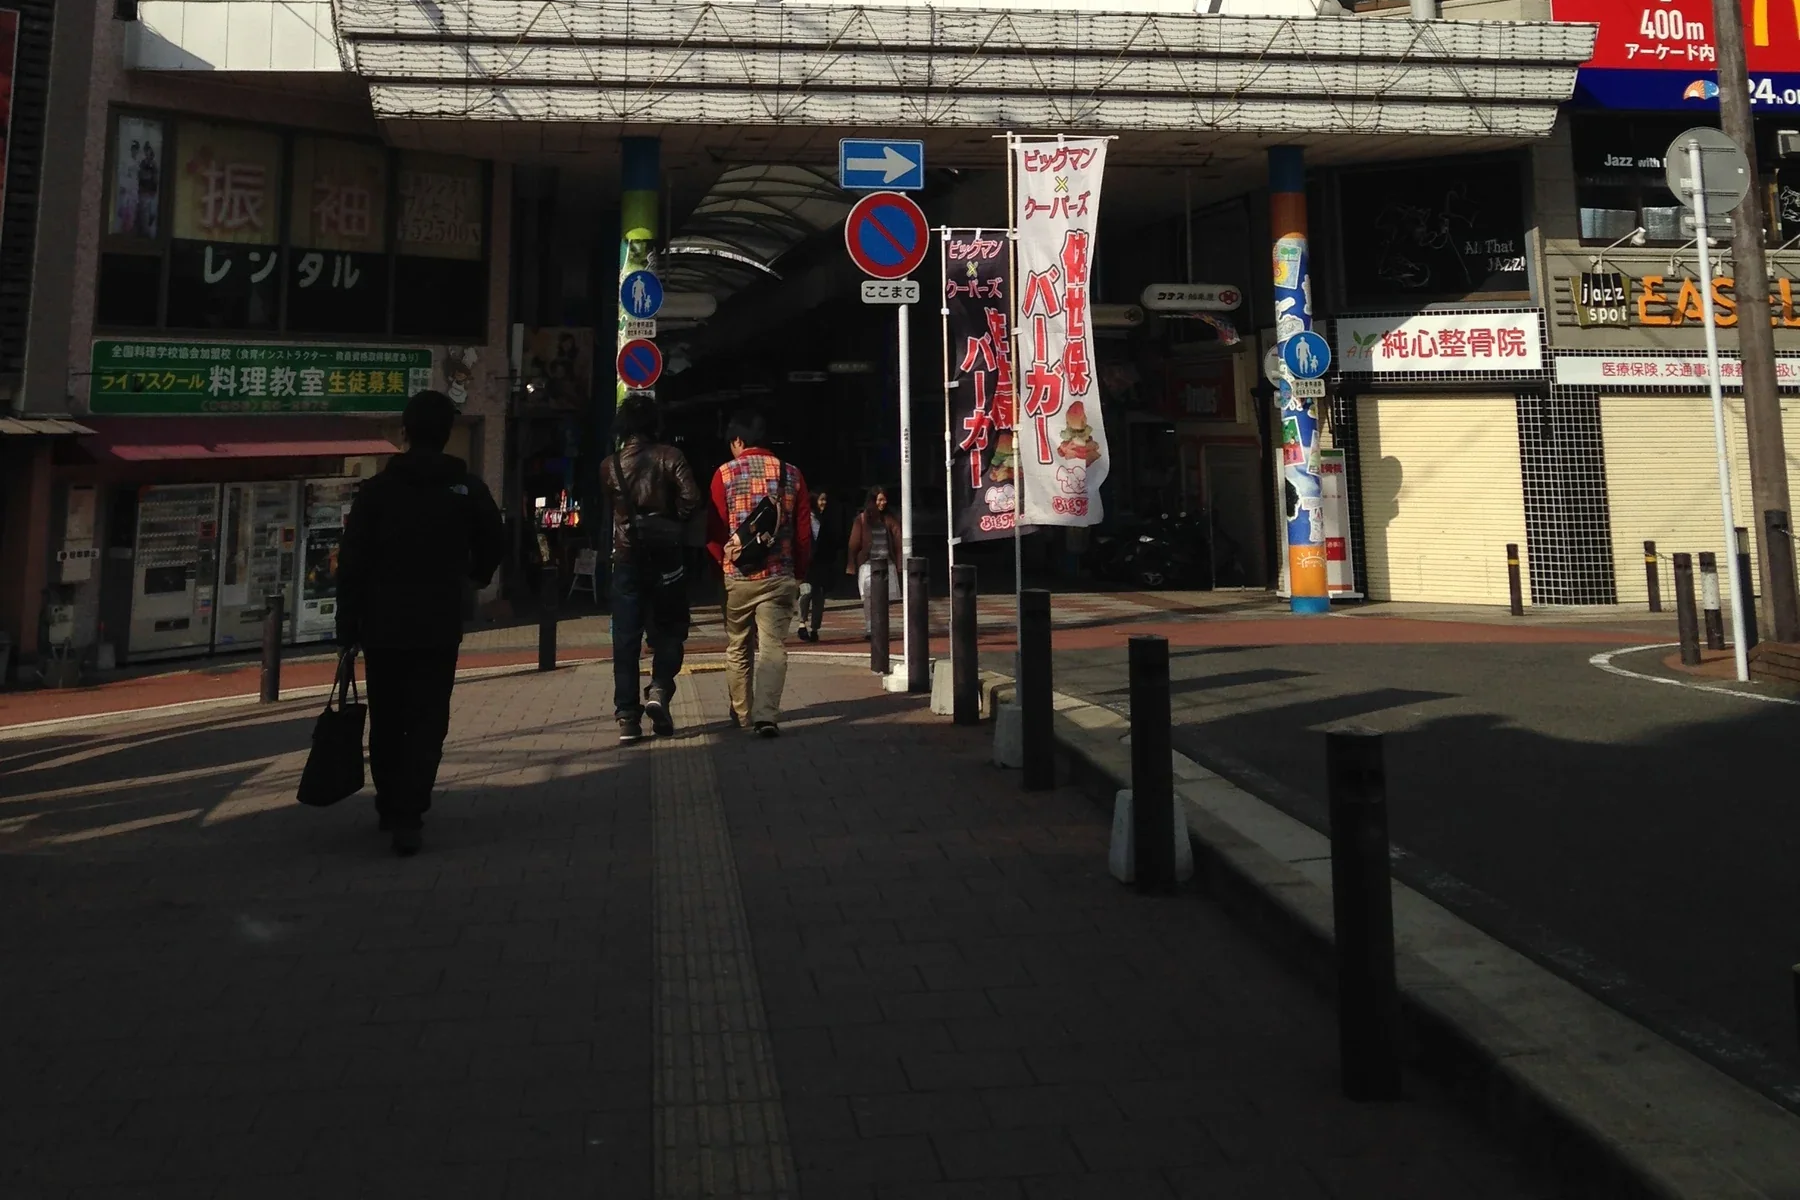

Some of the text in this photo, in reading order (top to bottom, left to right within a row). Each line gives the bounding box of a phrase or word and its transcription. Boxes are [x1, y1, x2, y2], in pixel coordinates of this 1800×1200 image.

[1640, 8, 1704, 41] 400m
[1625, 43, 1715, 62] アーケード内
[1024, 147, 1098, 174] ビッグマン
[1604, 153, 1661, 169] Jazz with
[1485, 238, 1515, 254] That
[204, 246, 361, 289] レンタル
[864, 285, 917, 299] ここまで
[1582, 284, 1625, 304] jazz
[1061, 229, 1091, 397] 佐世保
[1589, 305, 1628, 323] spot
[1381, 326, 1528, 359] 純心整骨院
[1022, 263, 1066, 465] バーガー
[208, 364, 325, 398] 料理教室
[328, 367, 405, 395] 生徒募集
